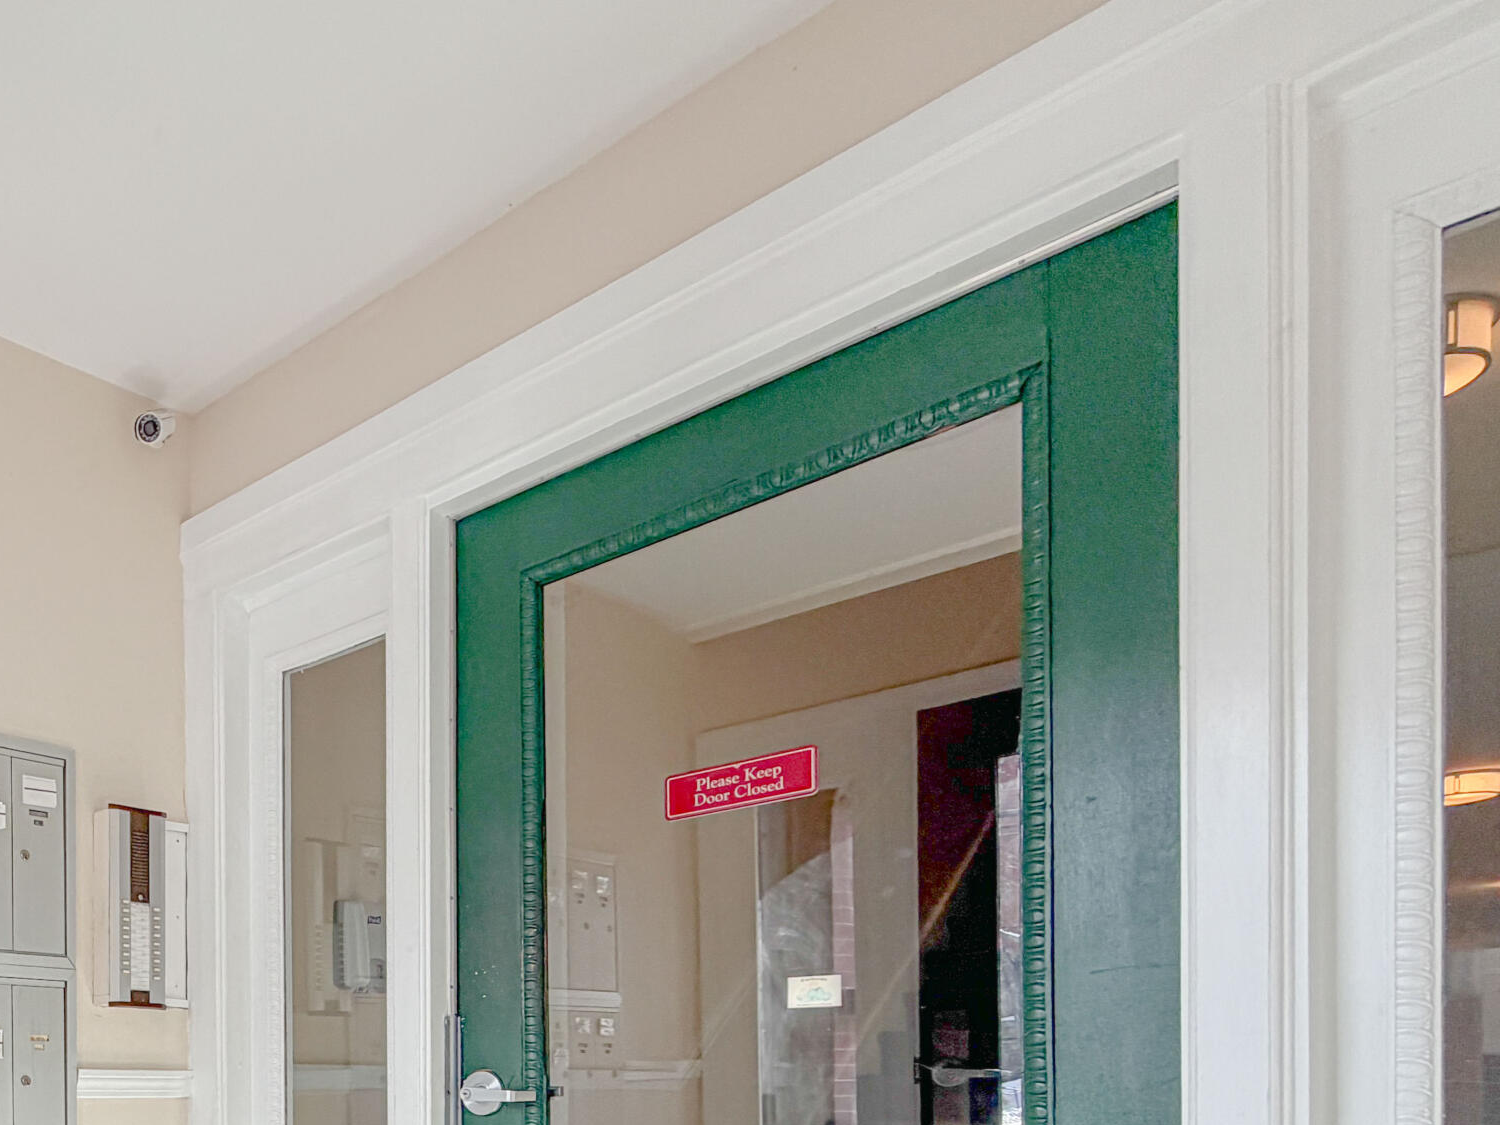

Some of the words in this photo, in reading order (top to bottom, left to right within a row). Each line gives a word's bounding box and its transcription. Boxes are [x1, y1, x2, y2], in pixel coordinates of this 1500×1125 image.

[693, 790, 731, 808] Door
[734, 775, 785, 799] Closed
[695, 774, 740, 793] Please
[744, 765, 783, 783] Keep
